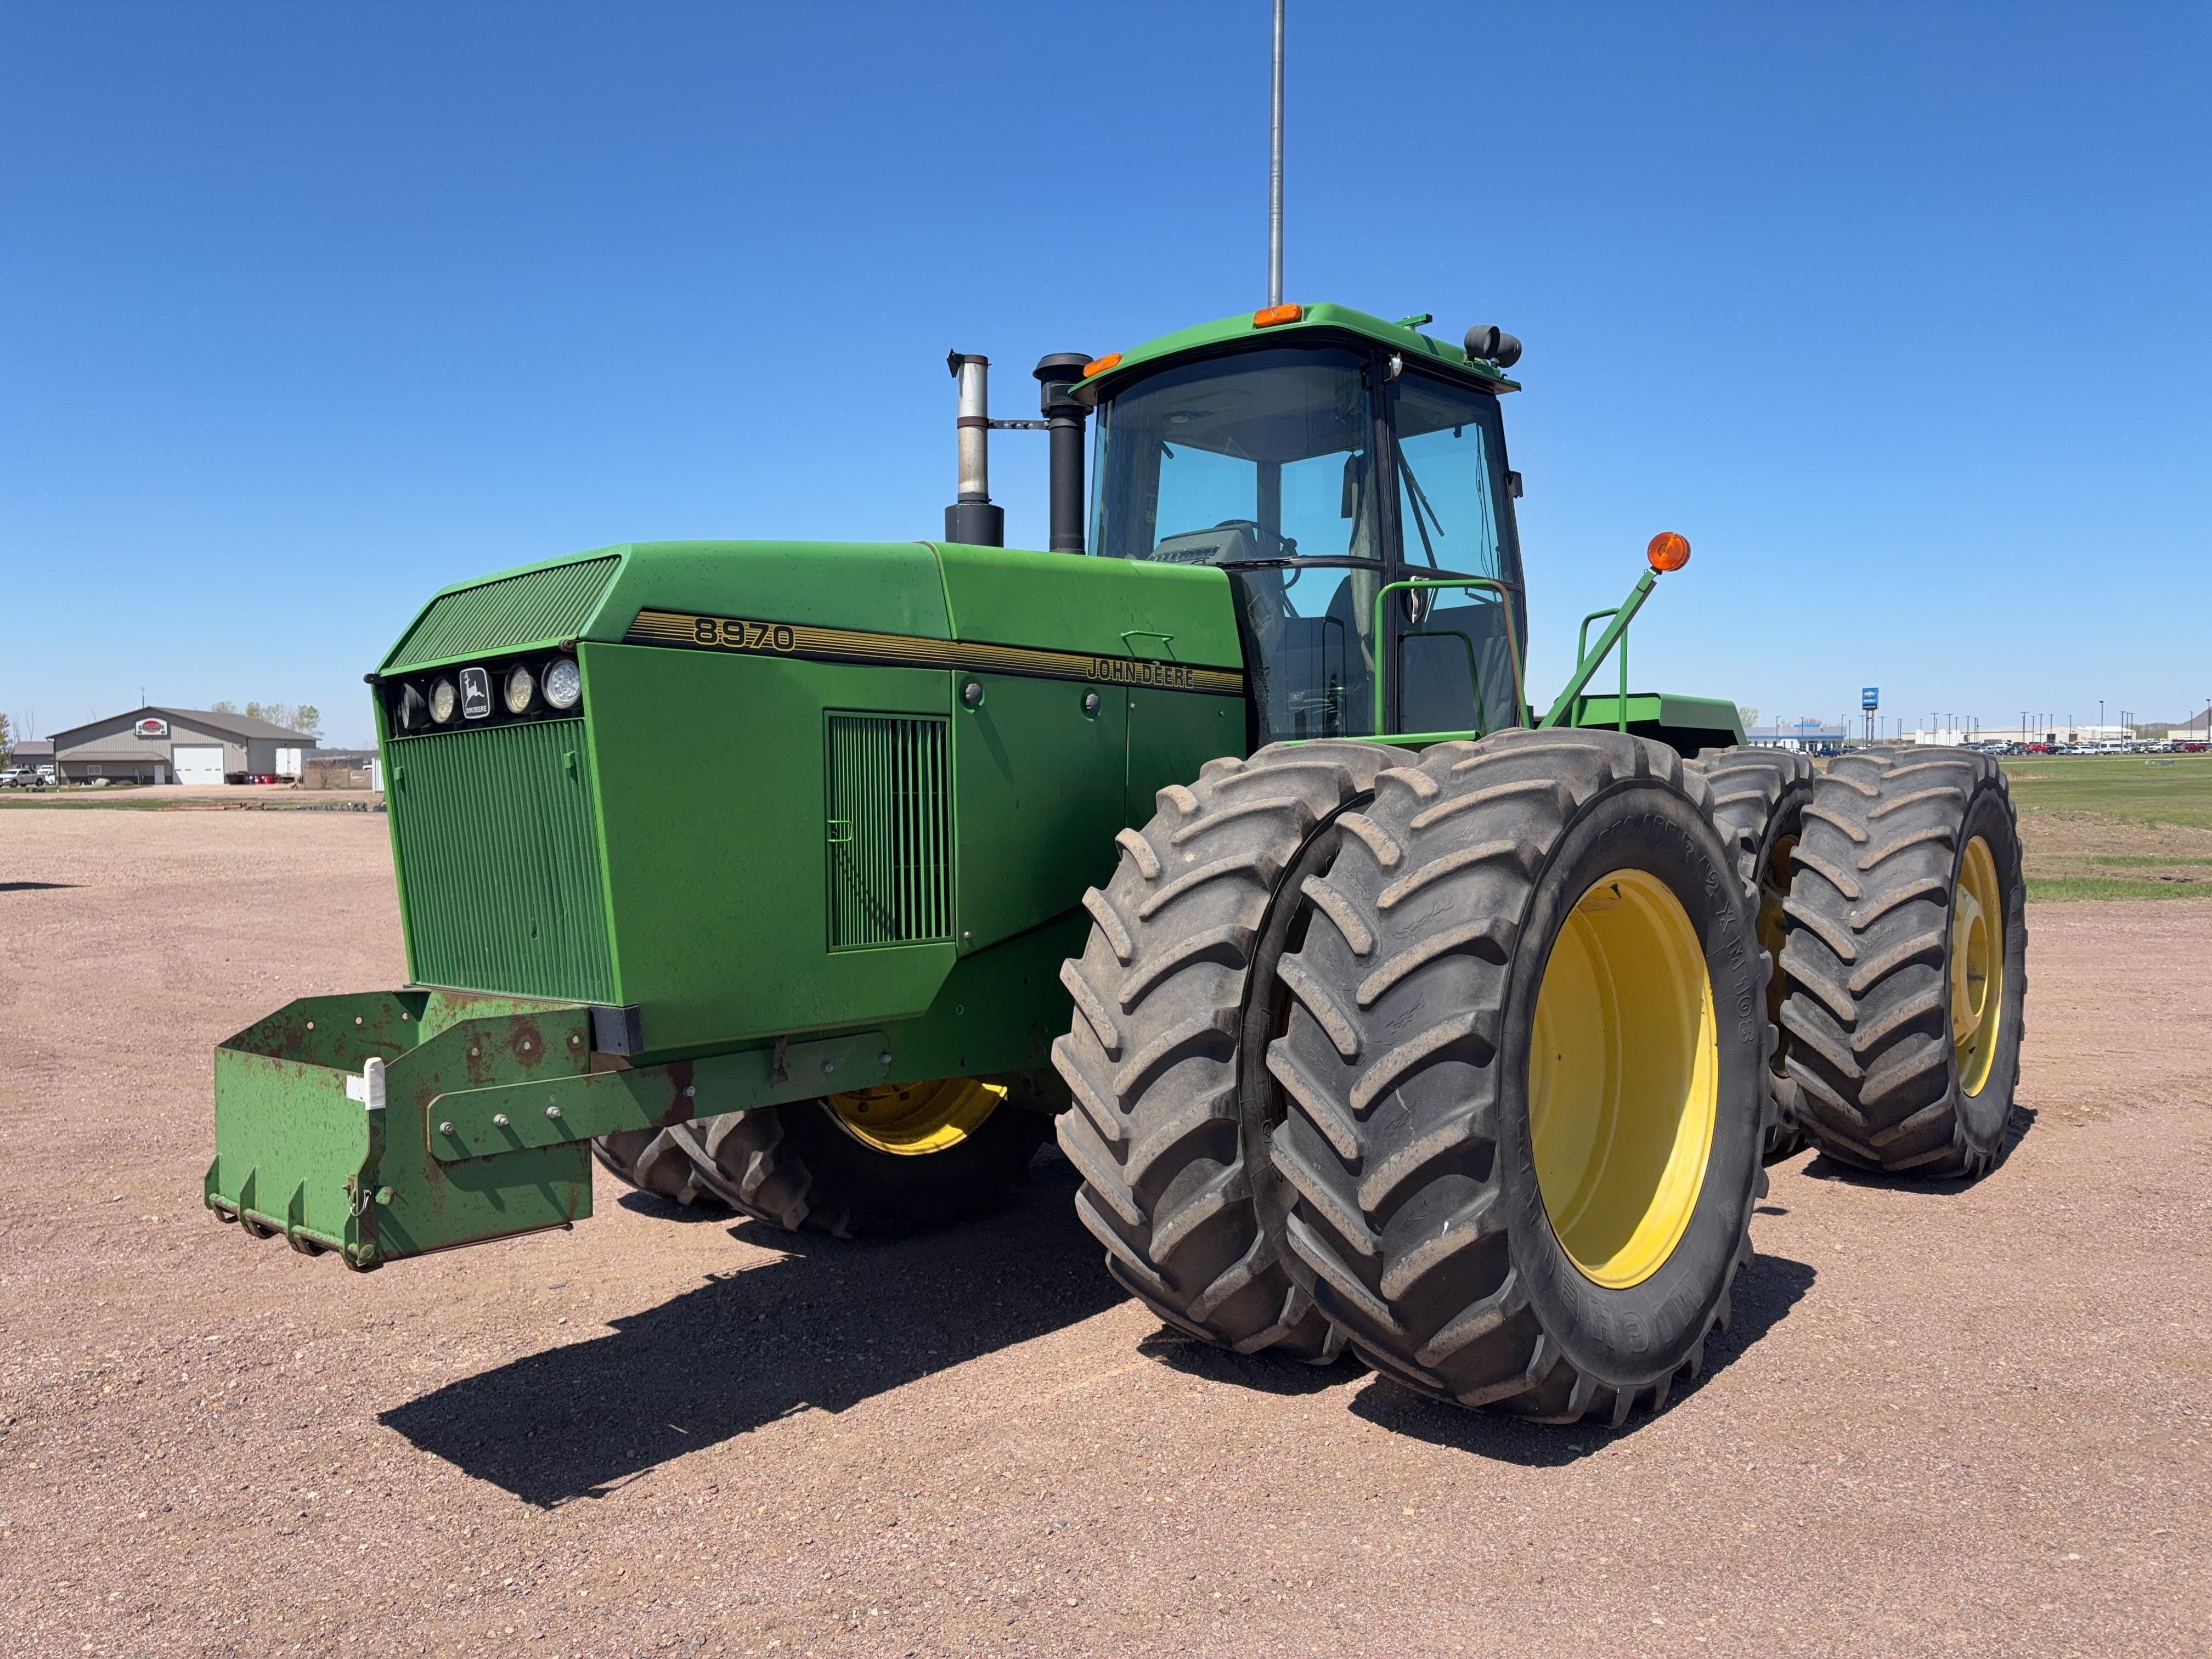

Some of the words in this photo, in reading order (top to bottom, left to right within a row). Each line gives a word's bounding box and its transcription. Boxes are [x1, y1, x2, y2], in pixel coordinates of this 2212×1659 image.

[693, 618, 795, 652] 8970
[1086, 658, 1137, 683] JOHN
[1142, 664, 1194, 689] DEERE
